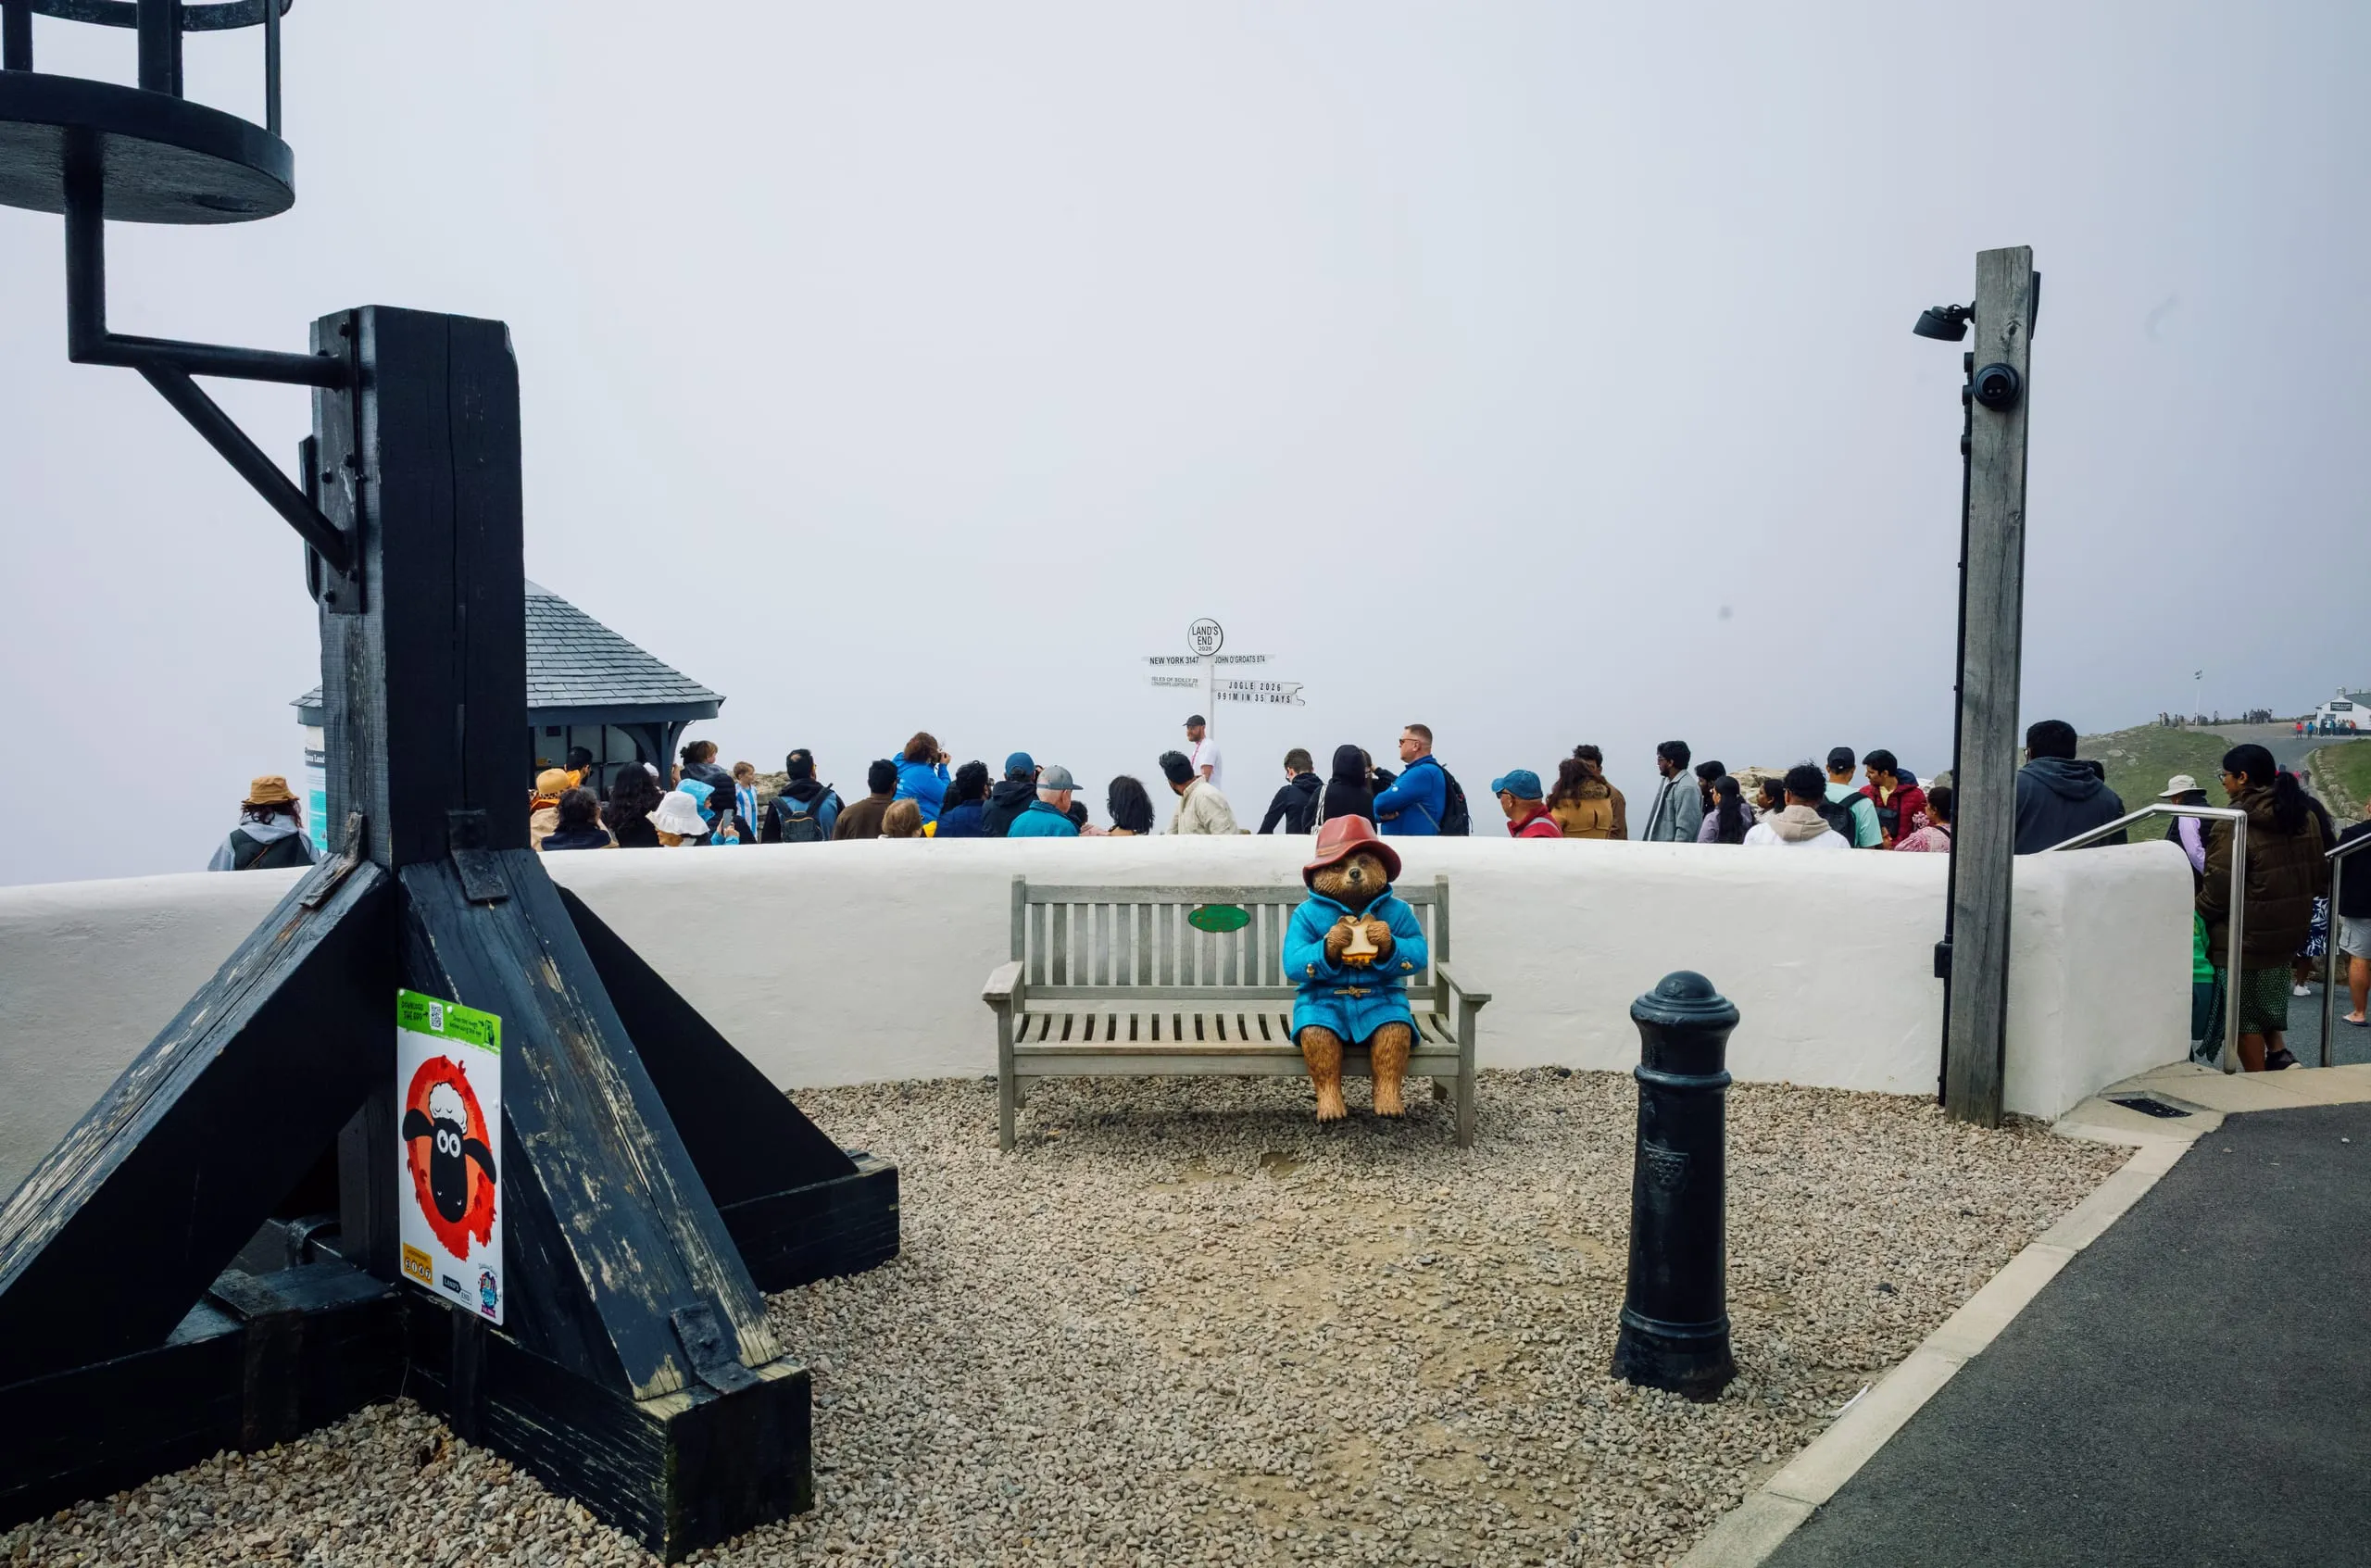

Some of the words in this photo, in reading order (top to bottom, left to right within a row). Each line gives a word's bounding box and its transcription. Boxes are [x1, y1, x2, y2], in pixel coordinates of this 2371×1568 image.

[1192, 626, 1219, 635] LAND'S
[1198, 635, 1213, 646] END
[1149, 657, 1165, 665] NEW
[1166, 657, 1185, 665] YORK
[1185, 656, 1199, 665] 3147
[1214, 656, 1229, 664] JOHN
[1229, 655, 1256, 664] O'GROATS
[1229, 681, 1254, 690] JOGLE
[1260, 683, 1281, 692] 2026
[1217, 692, 1238, 701] 991M
[1255, 694, 1264, 702] 35
[1270, 695, 1290, 704] DAYS
[445, 1277, 460, 1291] LAND'S
